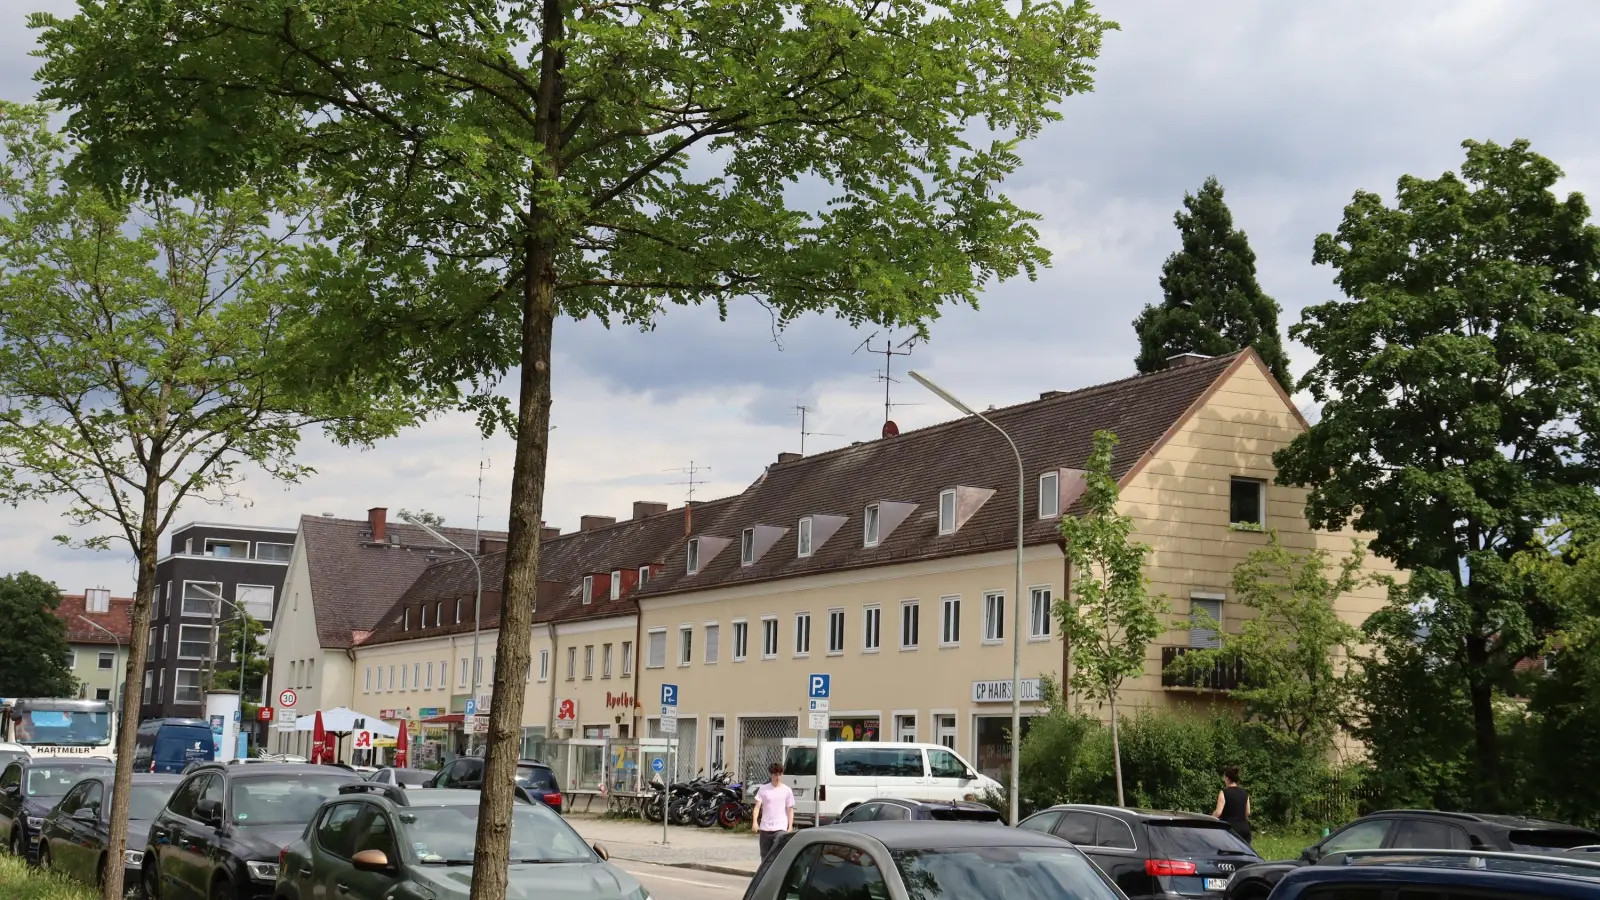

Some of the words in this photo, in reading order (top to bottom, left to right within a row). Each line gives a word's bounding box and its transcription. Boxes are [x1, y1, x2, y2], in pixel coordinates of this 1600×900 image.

[812, 676, 824, 695] P
[976, 683, 986, 699] CP
[283, 694, 294, 703] 30
[663, 686, 674, 703] P
[466, 701, 475, 713] P
[37, 746, 90, 754] HARTMEIER
